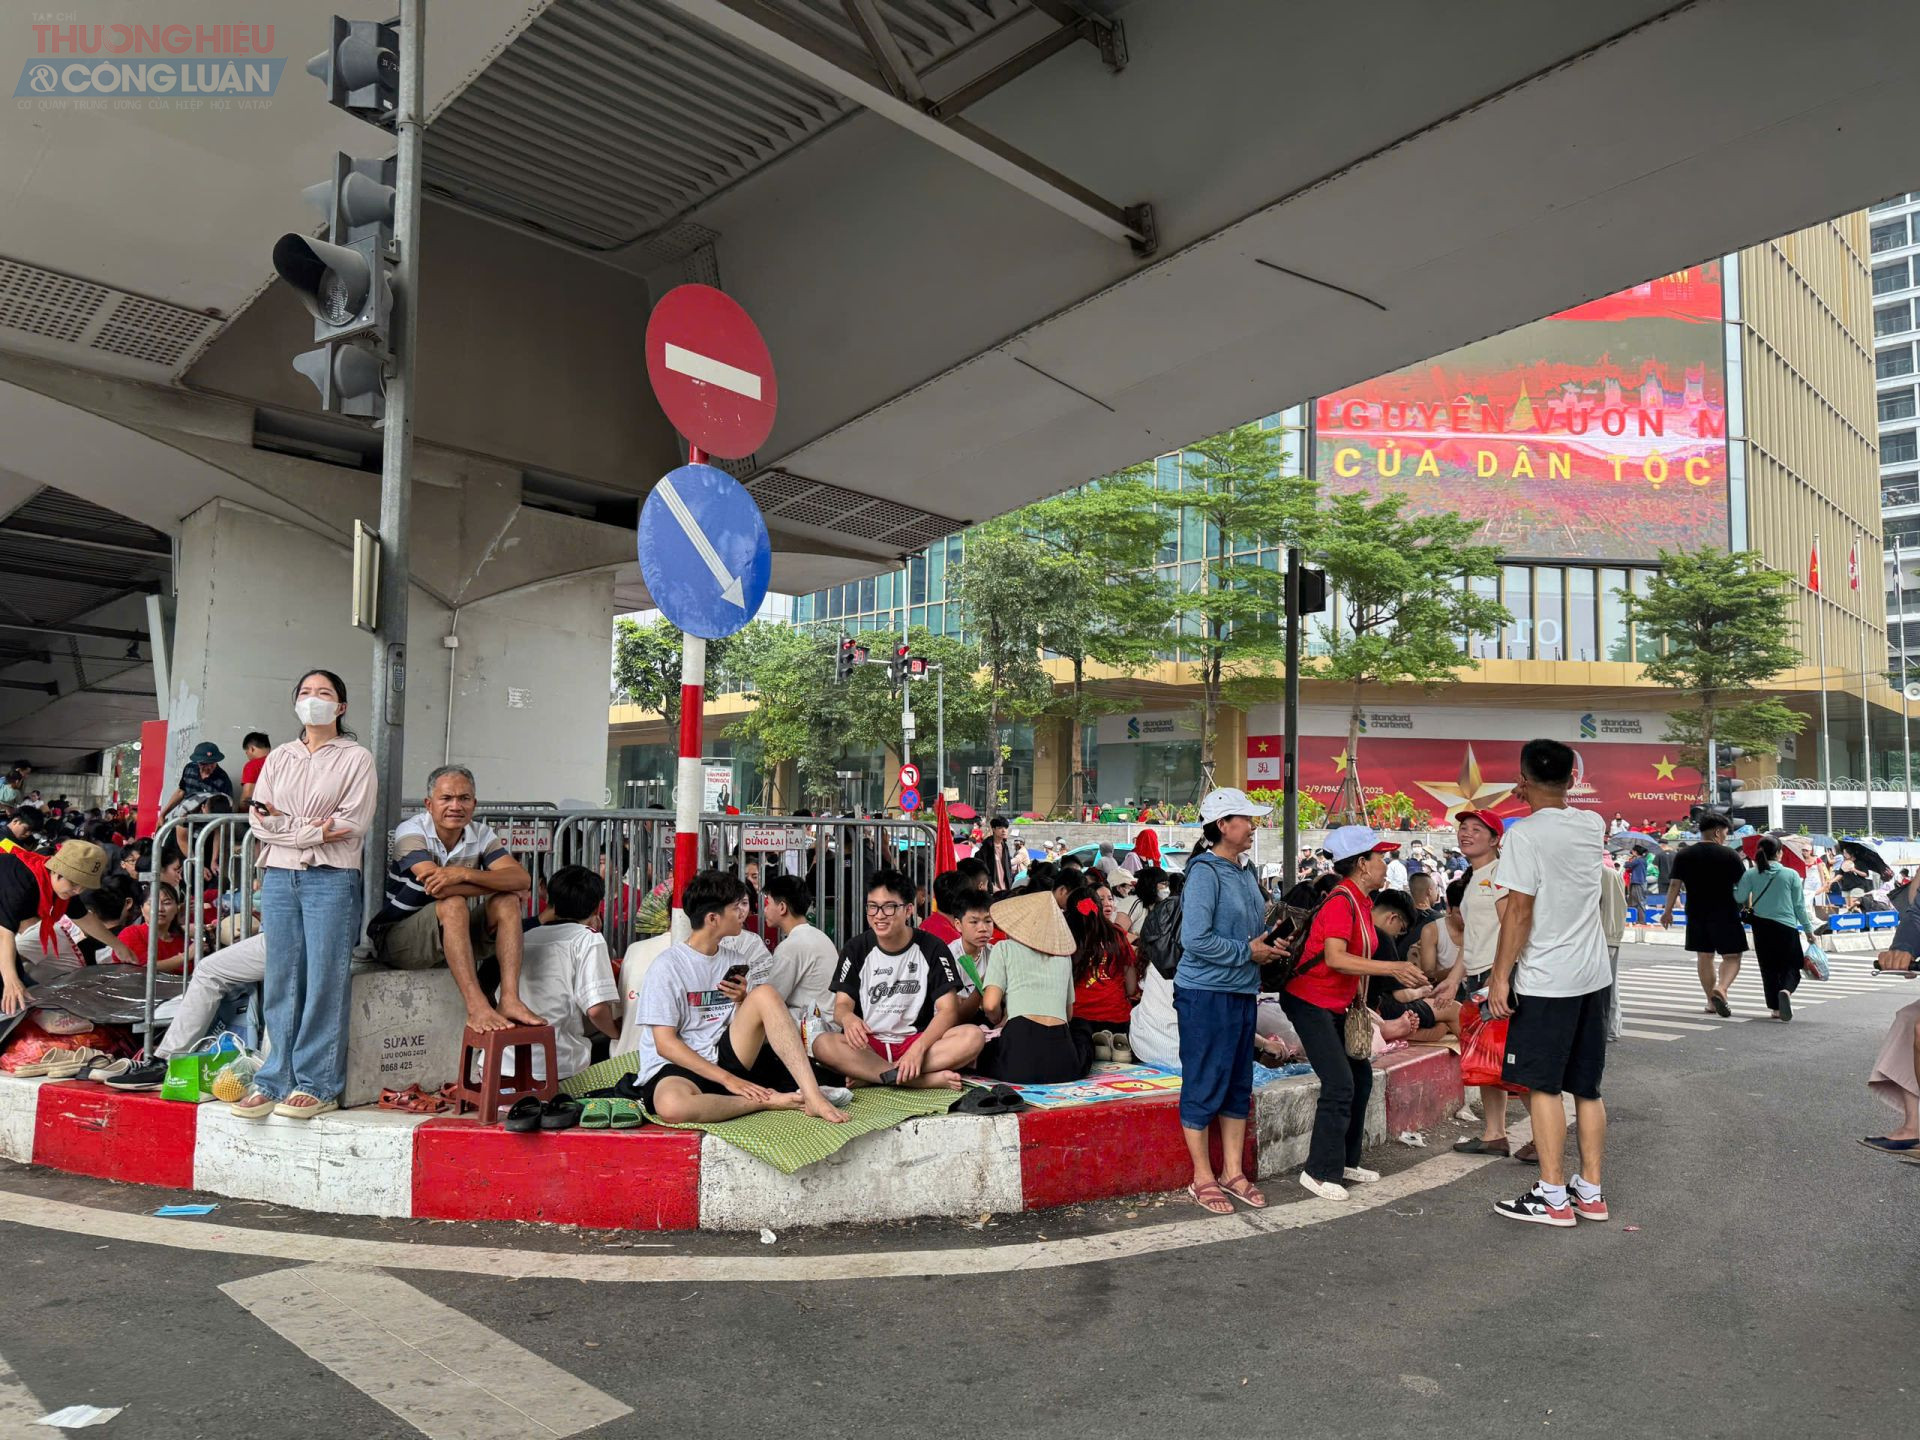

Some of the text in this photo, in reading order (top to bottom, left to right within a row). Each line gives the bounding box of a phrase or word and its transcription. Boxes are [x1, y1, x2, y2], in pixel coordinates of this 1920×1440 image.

[1334, 439, 1711, 489] CỦA DÂN TỘC
[1371, 714, 1411, 722] standard
[1601, 718, 1639, 726] standard
[1643, 792, 1665, 800] LOVE
[745, 835, 784, 847] DỪNG LẠI
[411, 1035, 425, 1047] XE
